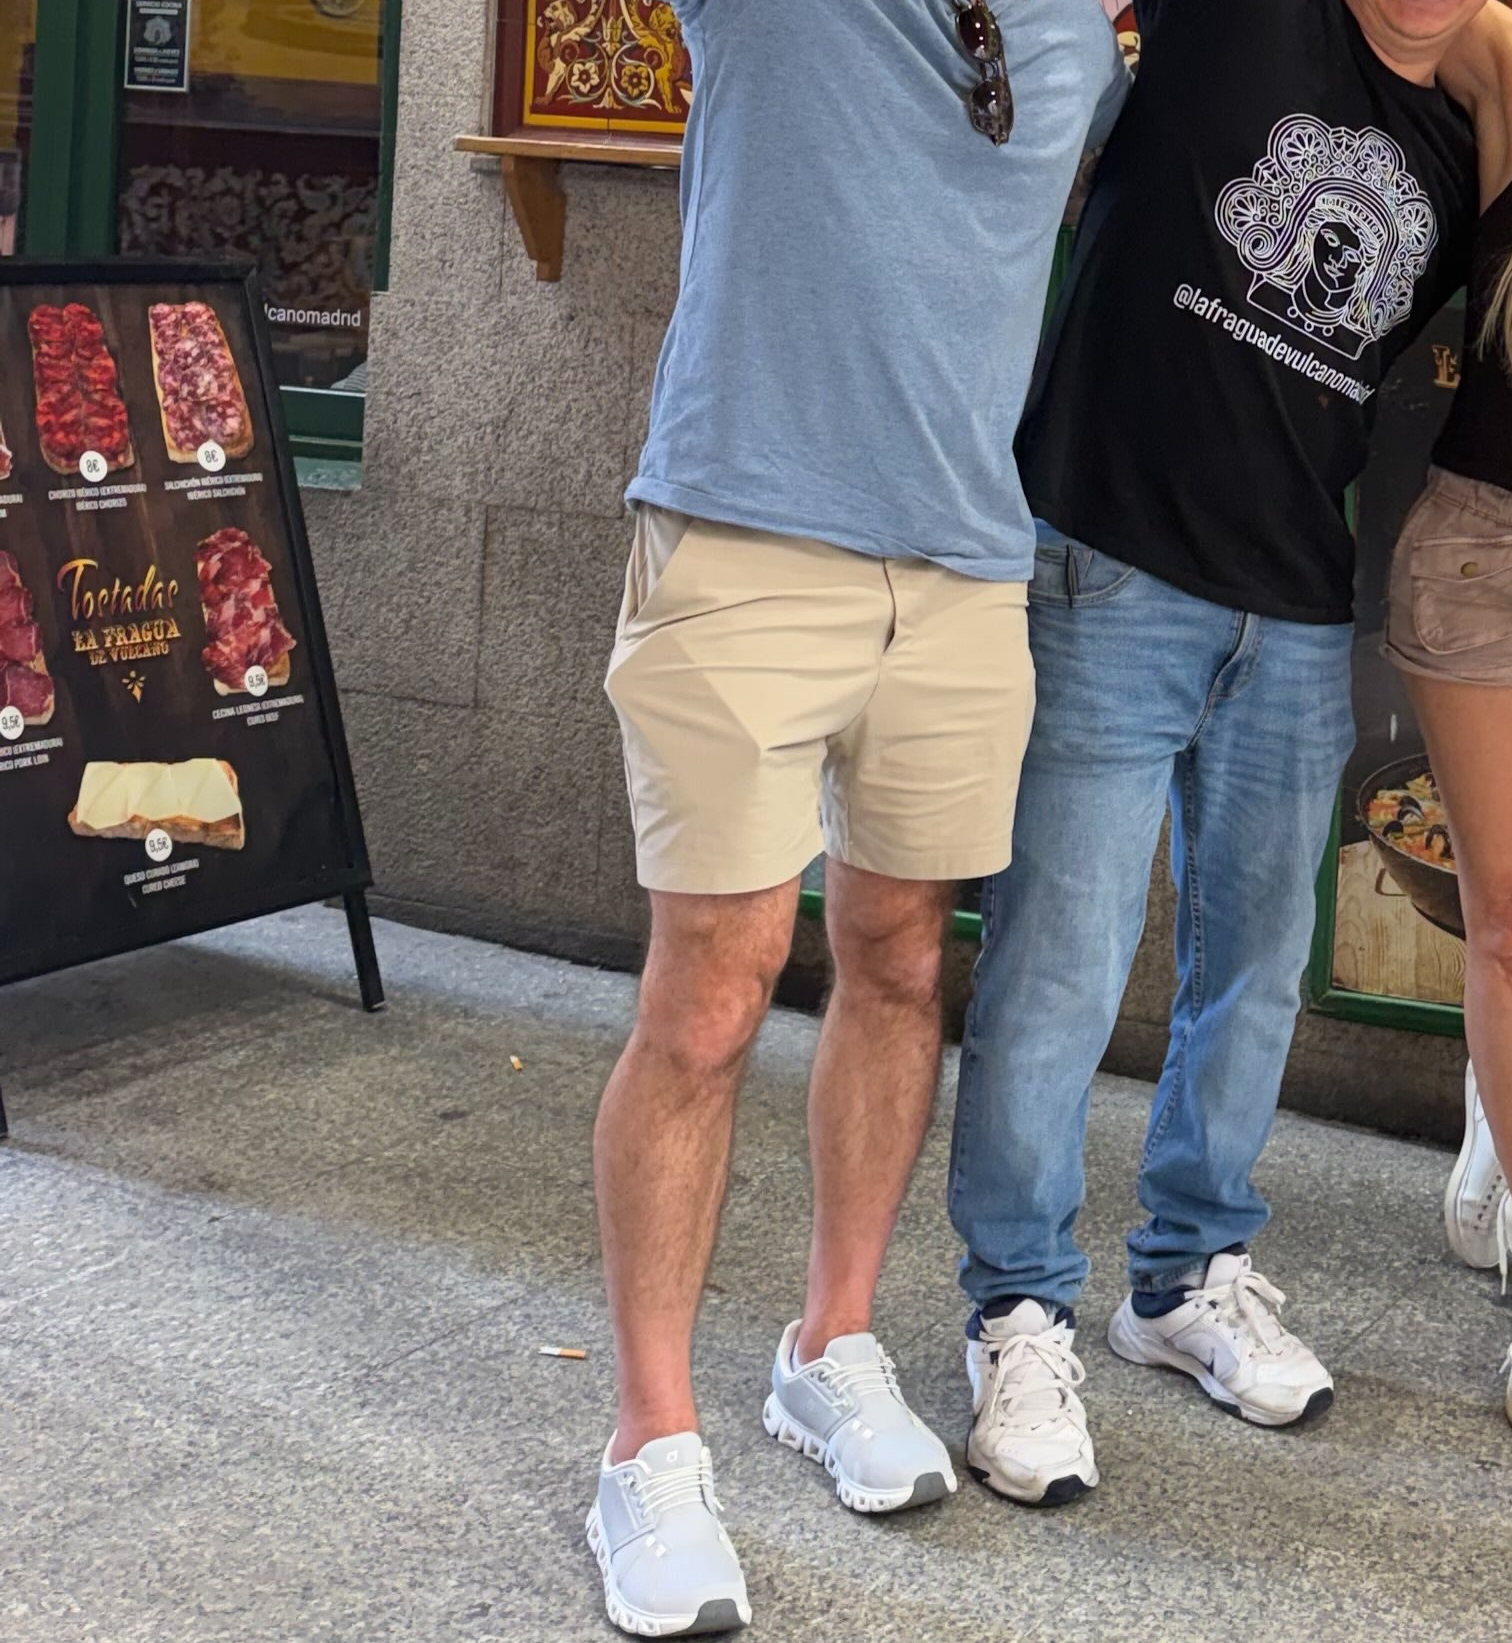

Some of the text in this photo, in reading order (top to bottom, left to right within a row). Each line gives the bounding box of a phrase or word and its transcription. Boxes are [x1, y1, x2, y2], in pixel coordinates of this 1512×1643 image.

[56, 558, 178, 621] Tostadas
[71, 617, 182, 651] LA FRAGUA
